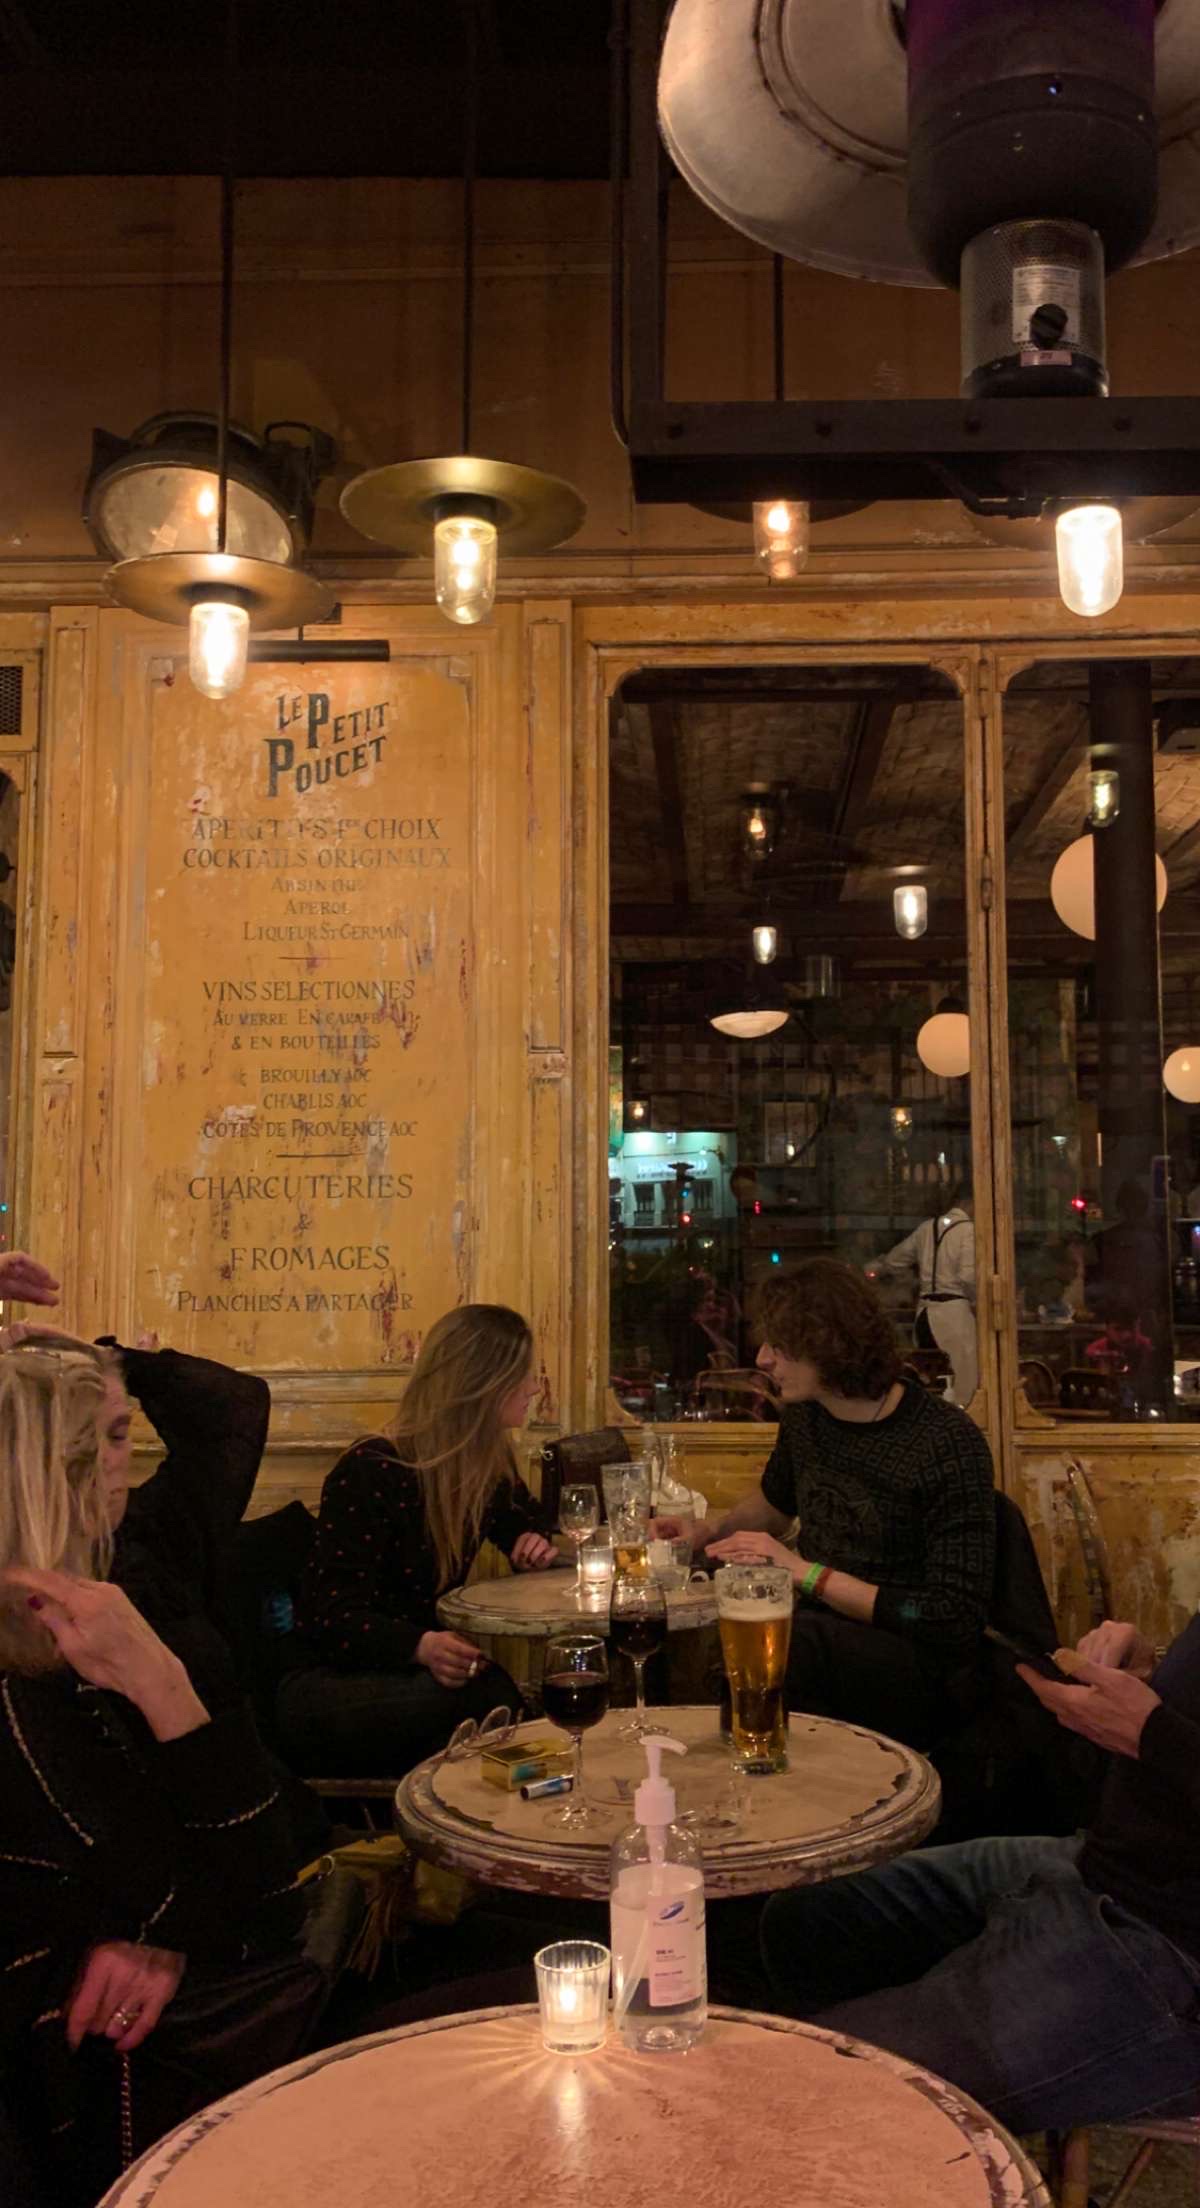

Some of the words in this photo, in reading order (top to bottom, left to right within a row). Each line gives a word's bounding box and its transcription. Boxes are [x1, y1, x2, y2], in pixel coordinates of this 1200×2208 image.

[276, 694, 303, 730] LE
[306, 692, 390, 749] PETIT
[263, 735, 387, 797] POUCET
[364, 815, 442, 840] CHOIX
[183, 847, 308, 871] COCKTAILS
[317, 847, 453, 871] ORIGINAUX
[340, 922, 410, 940] GERMAIN
[203, 980, 257, 1001] VINS
[260, 979, 415, 1001] SELECTIONNES
[298, 1008, 321, 1025] EN
[231, 1035, 242, 1050] &
[250, 1035, 273, 1049] EN
[260, 1068, 342, 1084] BROUILLY
[263, 1092, 334, 1110] CHABLIS
[336, 1092, 368, 1108] AOC
[266, 1121, 287, 1137] DE
[291, 1118, 386, 1138] PROVENCE
[390, 1121, 418, 1137] AOC
[188, 1174, 413, 1201] CHARCUTERIES
[230, 1246, 390, 1271] FROMAGES
[177, 1290, 283, 1312] PLANCHES
